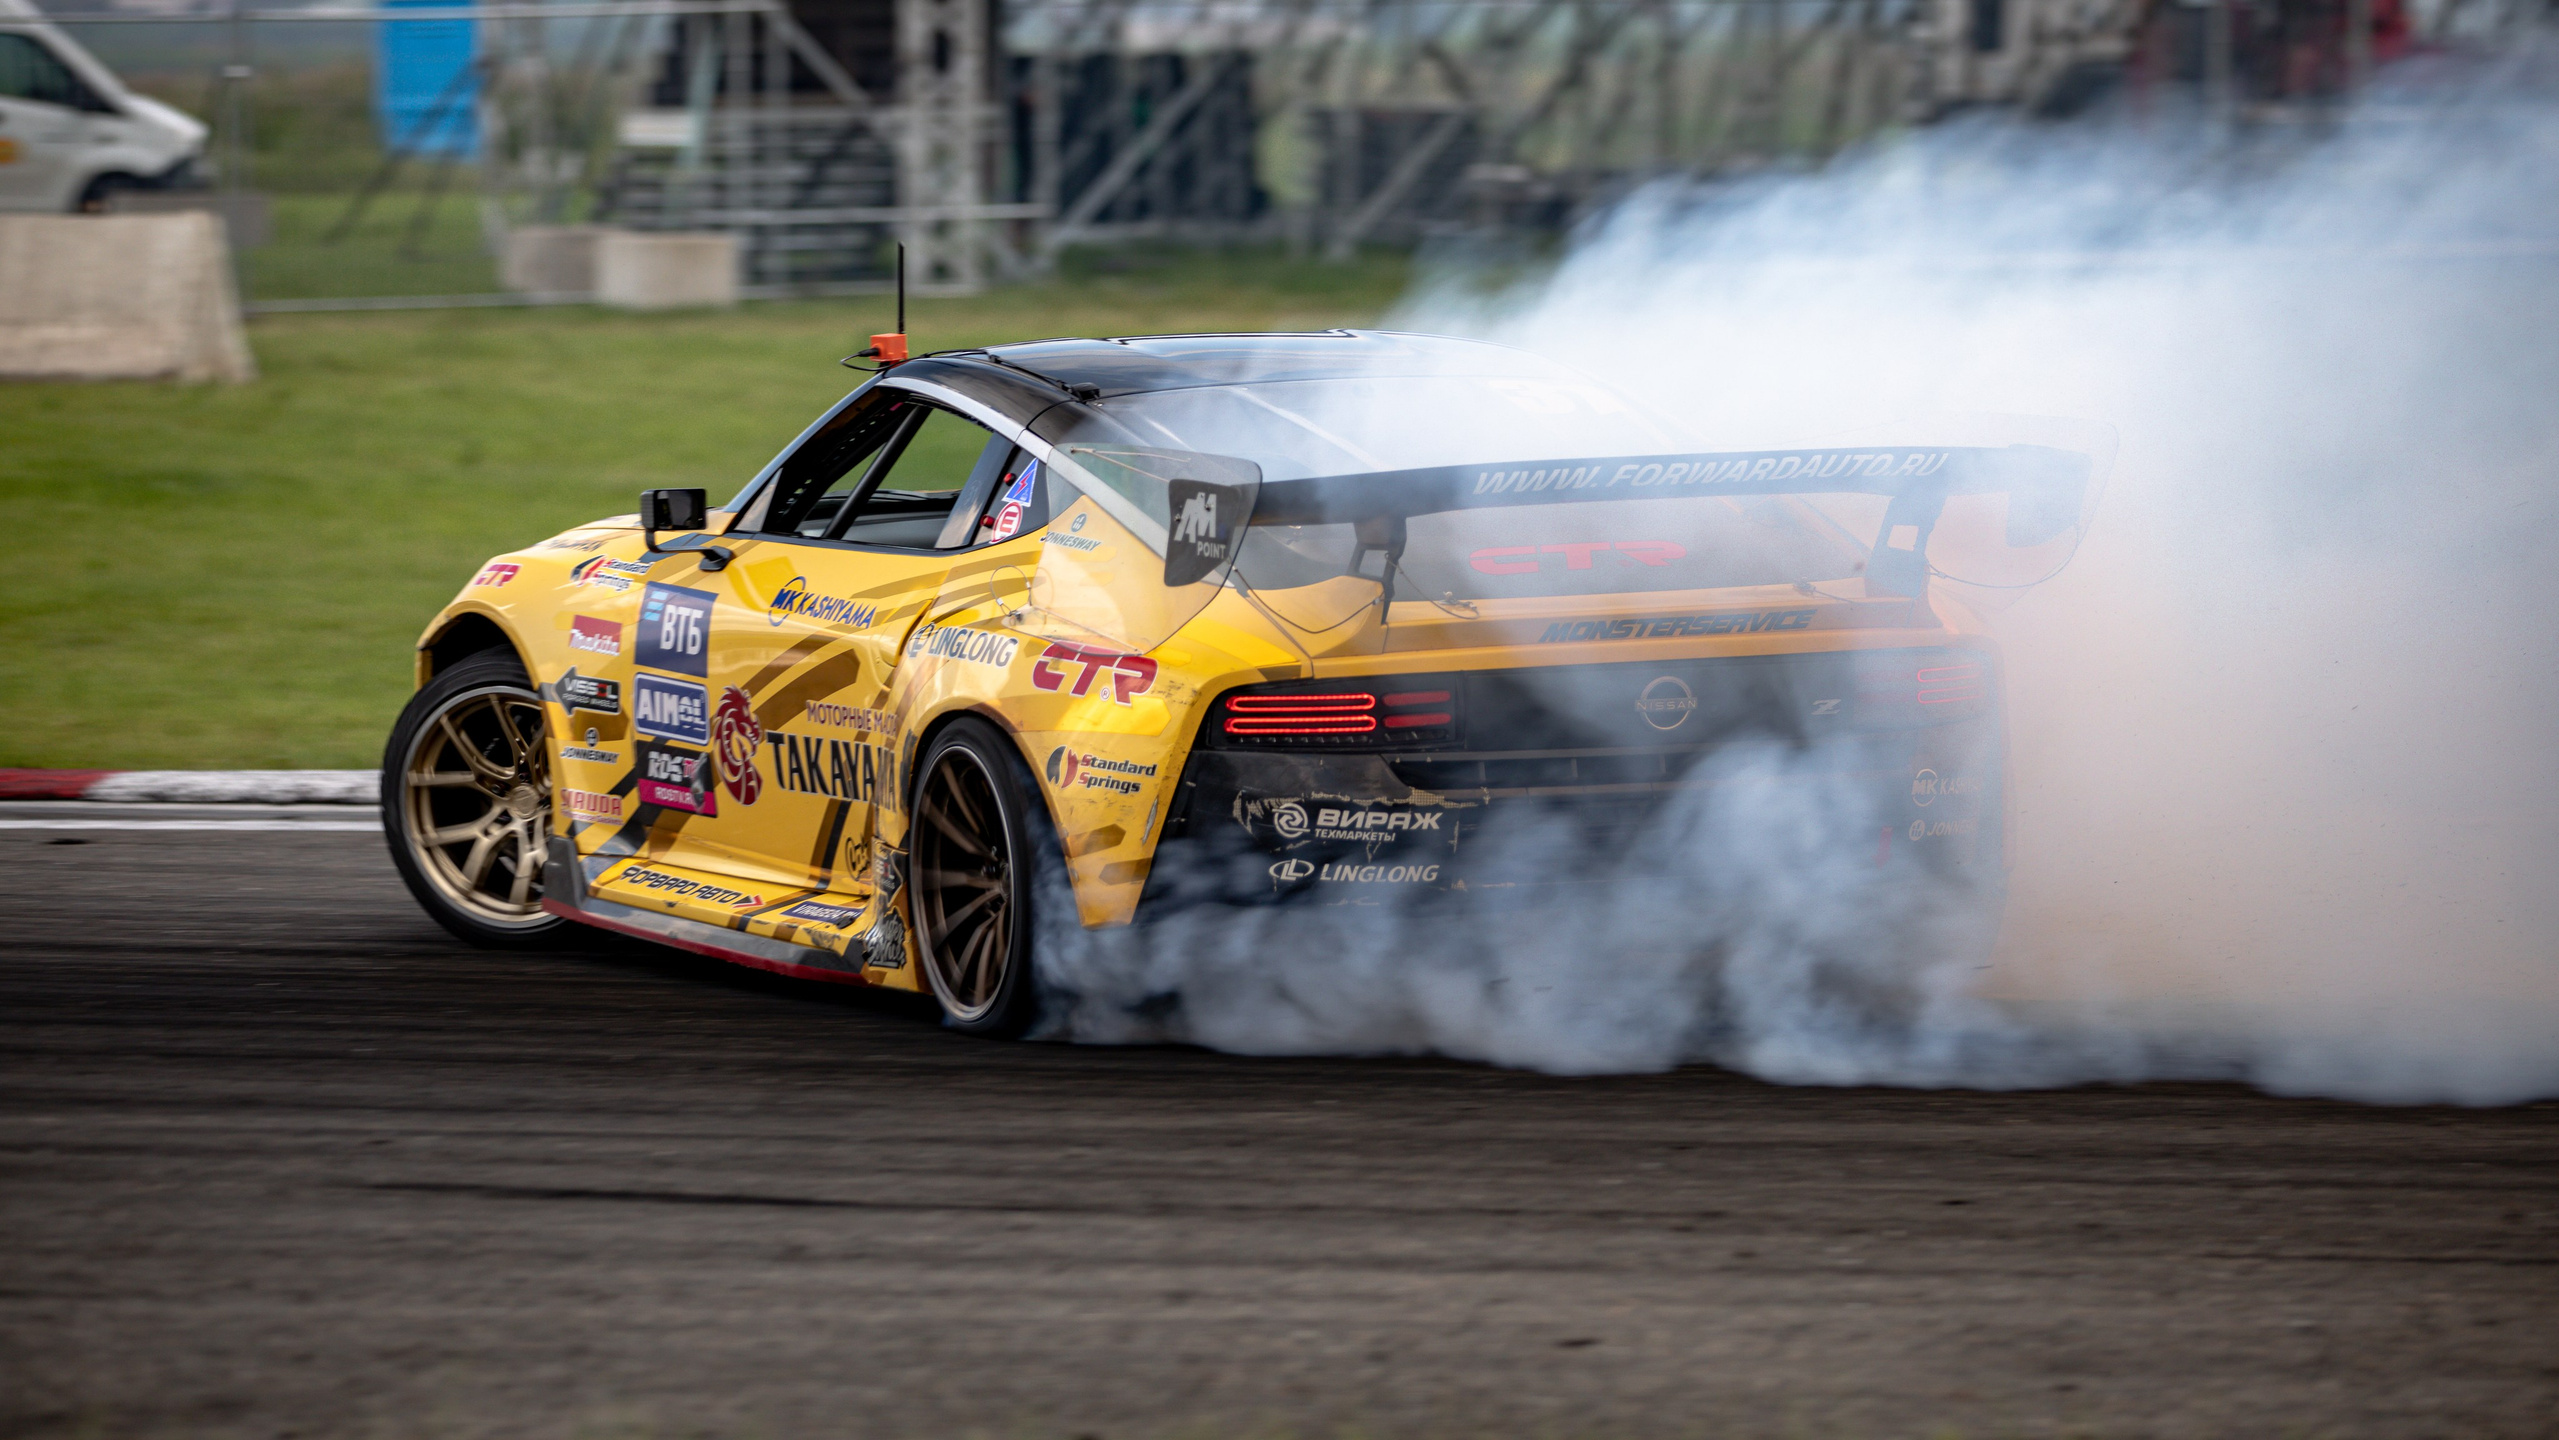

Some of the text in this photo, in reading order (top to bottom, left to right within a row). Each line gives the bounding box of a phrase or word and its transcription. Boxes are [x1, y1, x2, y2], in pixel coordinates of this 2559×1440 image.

[1040, 531, 1101, 552] JONNESWAY
[1197, 541, 1226, 559] POINT
[1469, 540, 1687, 576] CTR
[796, 590, 877, 629] KASHIYAMA
[660, 604, 705, 655] ВТБ
[1538, 609, 1817, 643] MONSTERSERVICE
[927, 626, 1019, 669] LINGLONG
[636, 688, 706, 731] AIMOL
[806, 700, 872, 732] МОТОРНЫЕ
[1636, 699, 1697, 711] NISSAN
[1811, 699, 1841, 715] Z
[1080, 754, 1157, 777] Standard
[1078, 772, 1141, 795] Springs
[1317, 808, 1443, 830] ВИРАЖ
[1315, 828, 1396, 842] ТЕХМАРКЕТЫ
[1320, 863, 1440, 883] LINGLONG
[620, 866, 743, 904] ФОРВАРД АВТО
